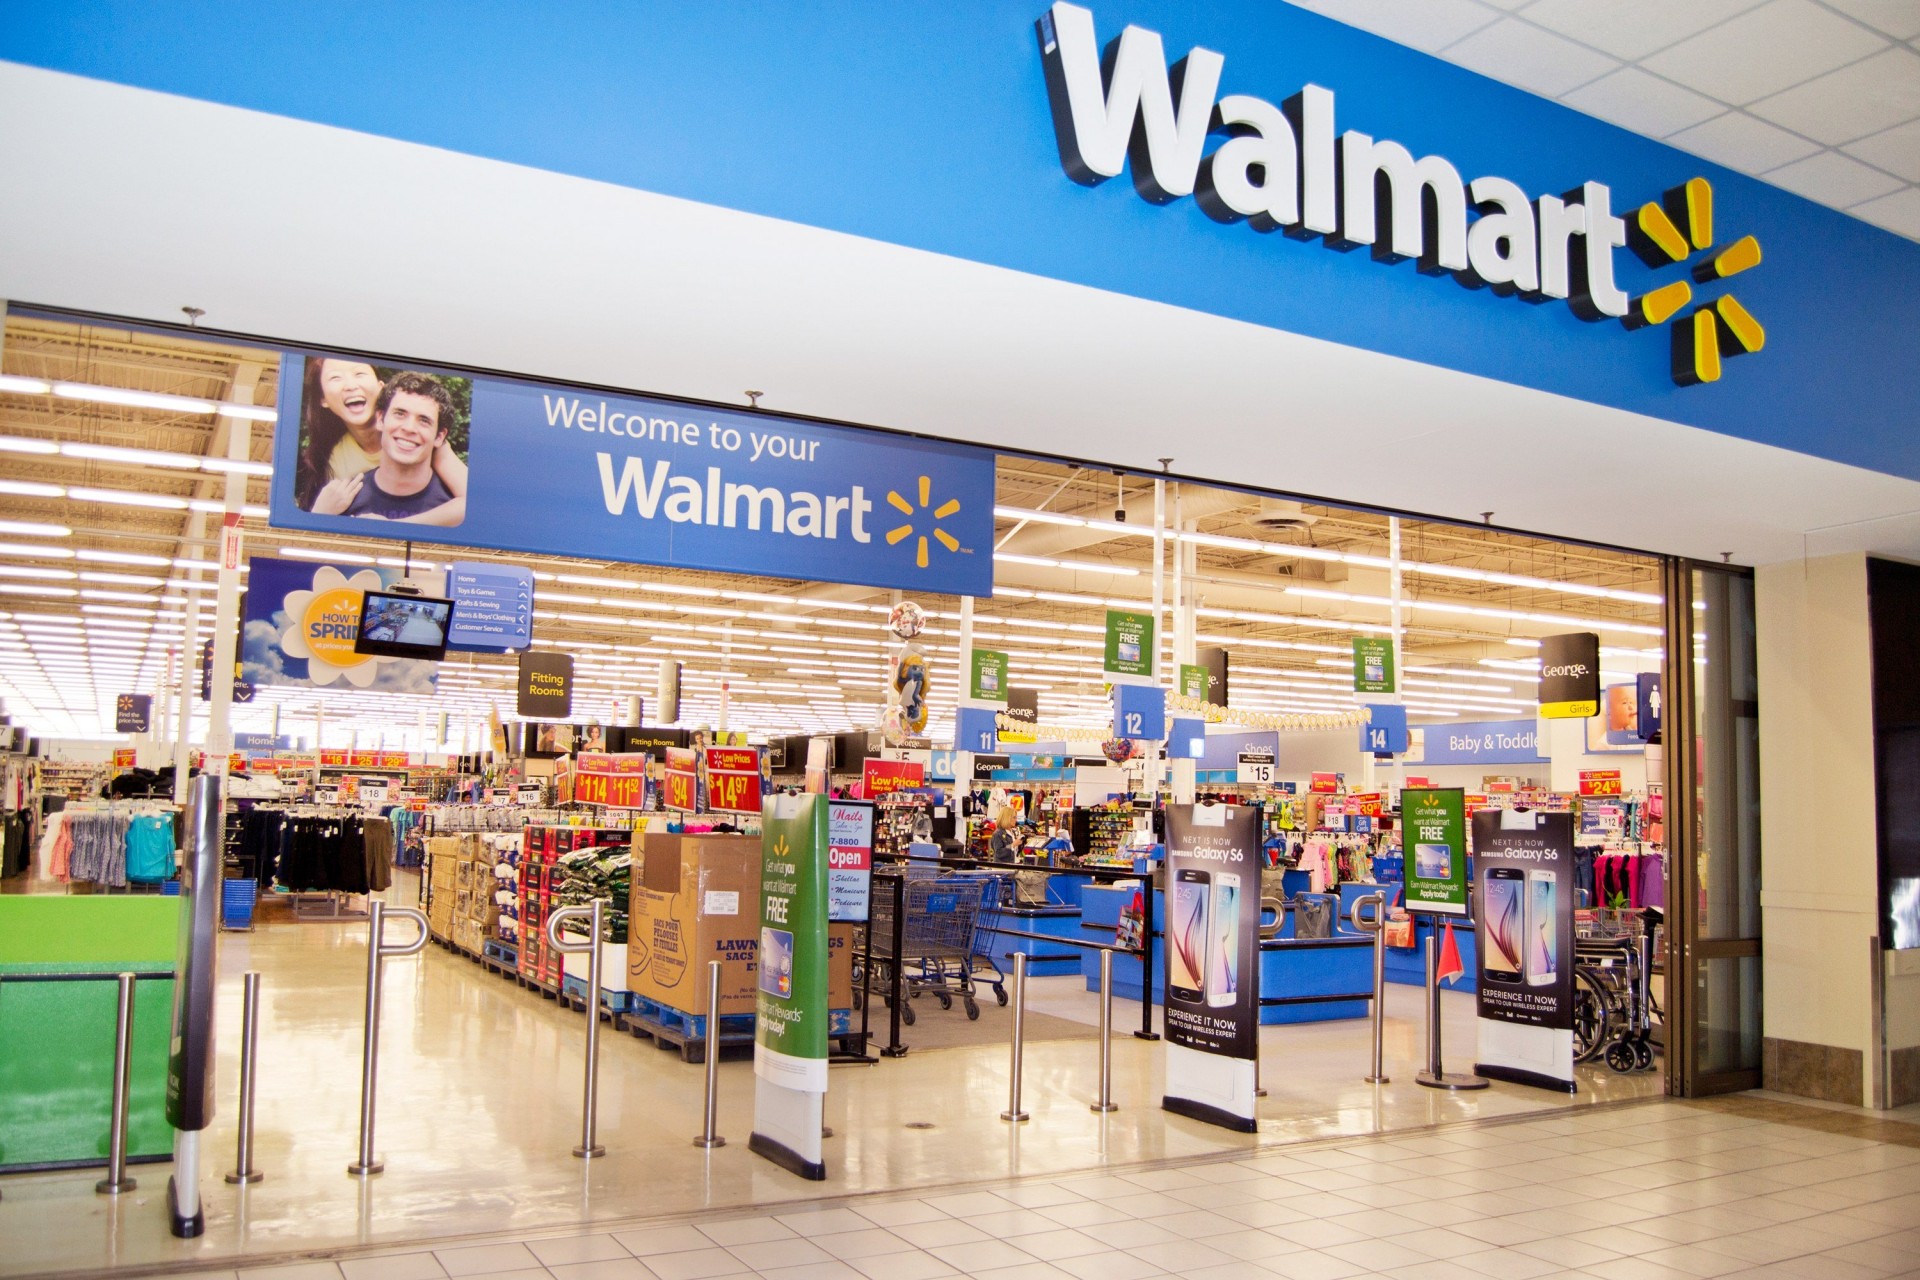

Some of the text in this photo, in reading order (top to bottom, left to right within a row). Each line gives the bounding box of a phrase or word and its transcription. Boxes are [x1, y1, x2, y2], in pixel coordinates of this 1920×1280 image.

[1042, 1, 1627, 319] Walmart
[543, 395, 820, 462] Welcome to your
[596, 452, 872, 544] Walmart
[457, 575, 476, 583] Home
[457, 587, 470, 596] Toys
[478, 601, 500, 610] Sewing
[321, 613, 349, 624] HOW
[492, 613, 516, 623] Clothing
[455, 623, 504, 633] Customer Service
[1119, 632, 1140, 645] FREE
[322, 643, 342, 651] prices
[1364, 656, 1383, 666] FREE
[982, 667, 998, 677] FREE
[1543, 663, 1590, 679] George.
[531, 672, 564, 686] Fitting
[1187, 680, 1201, 689] FREE
[529, 684, 564, 697] Rooms
[1003, 707, 1035, 719] George.
[1569, 702, 1590, 714] Girls
[1124, 712, 1142, 735] 12
[247, 736, 275, 746] Home
[631, 737, 675, 747] Fitting Rooms
[980, 733, 992, 750] 11
[1369, 729, 1387, 749] 14
[1450, 735, 1481, 754] Baby
[1484, 735, 1494, 749] &
[1244, 742, 1273, 754] Shoes
[722, 753, 751, 764] Low Prices
[1250, 766, 1269, 782] $15
[871, 775, 920, 788] Low Prices
[364, 789, 380, 798] $18
[580, 774, 608, 803] $114
[521, 793, 534, 801] $16
[833, 807, 864, 822] Nails
[1415, 807, 1447, 817] Get what you
[1328, 816, 1339, 825] $18
[1358, 819, 1367, 827] Gift
[1413, 818, 1424, 826] want
[1429, 818, 1450, 826] Walmart
[1604, 817, 1616, 827] $12
[1420, 826, 1444, 841] FREE
[1182, 835, 1232, 847] NEXT IS NOW
[829, 847, 862, 868] Open
[1171, 846, 1244, 864] SAMSUNG Galaxy S6
[1504, 847, 1543, 862] Galaxy
[1544, 848, 1558, 860] S6
[784, 863, 796, 878] you
[834, 886, 866, 895] Manicure
[1410, 880, 1421, 889] Earn
[1420, 881, 1440, 890] Walmart
[1419, 889, 1449, 900] Apply today!
[834, 898, 863, 907] Pedicure
[766, 895, 790, 924] FREE
[653, 918, 679, 932] SACS POUR
[653, 927, 679, 942] PELOUSES
[716, 940, 758, 951] LAWN
[725, 952, 754, 961] SACS
[1482, 988, 1523, 1002] EXPERIENCE
[1524, 994, 1532, 1003] IT
[1512, 1002, 1536, 1011] WIRELESS
[1536, 1004, 1557, 1012] EXPERT
[1168, 1007, 1202, 1025] EXPERIENCE
[1203, 1016, 1212, 1027] IT
[1168, 1018, 1179, 1026] SPEAK
[1183, 1022, 1192, 1030] OUR
[1192, 1024, 1215, 1035] WIRELESS
[1215, 1029, 1236, 1039] EXPERT
